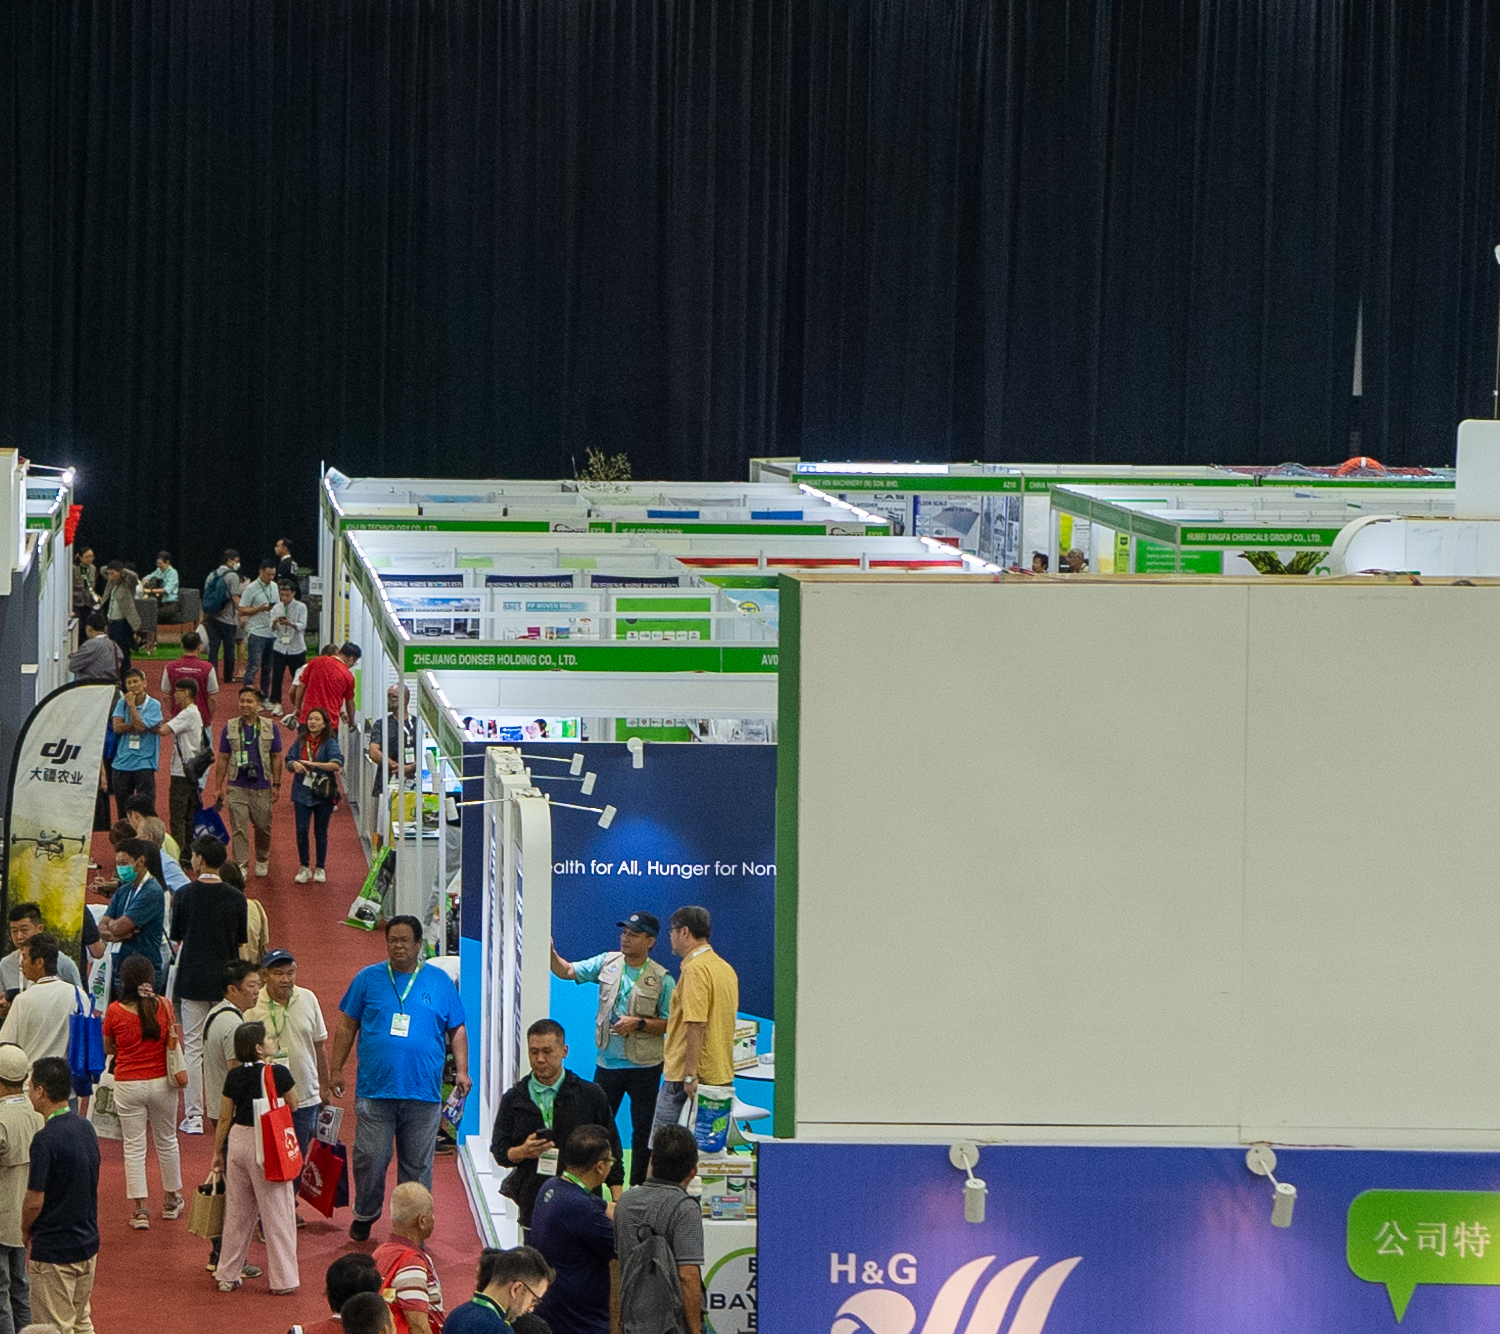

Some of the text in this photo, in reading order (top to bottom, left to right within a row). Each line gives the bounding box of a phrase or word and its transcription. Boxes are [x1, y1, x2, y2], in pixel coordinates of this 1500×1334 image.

[1231, 534, 1322, 543] CHEMICALS GROUP LTD.
[413, 653, 578, 666] ZHEJIANG DONSER HOLDING LTD.
[30, 766, 83, 785] 大疆农业
[590, 859, 736, 879] for All, Hunger for
[1373, 1220, 1492, 1261] 公司特
[829, 1252, 918, 1286] H&G
